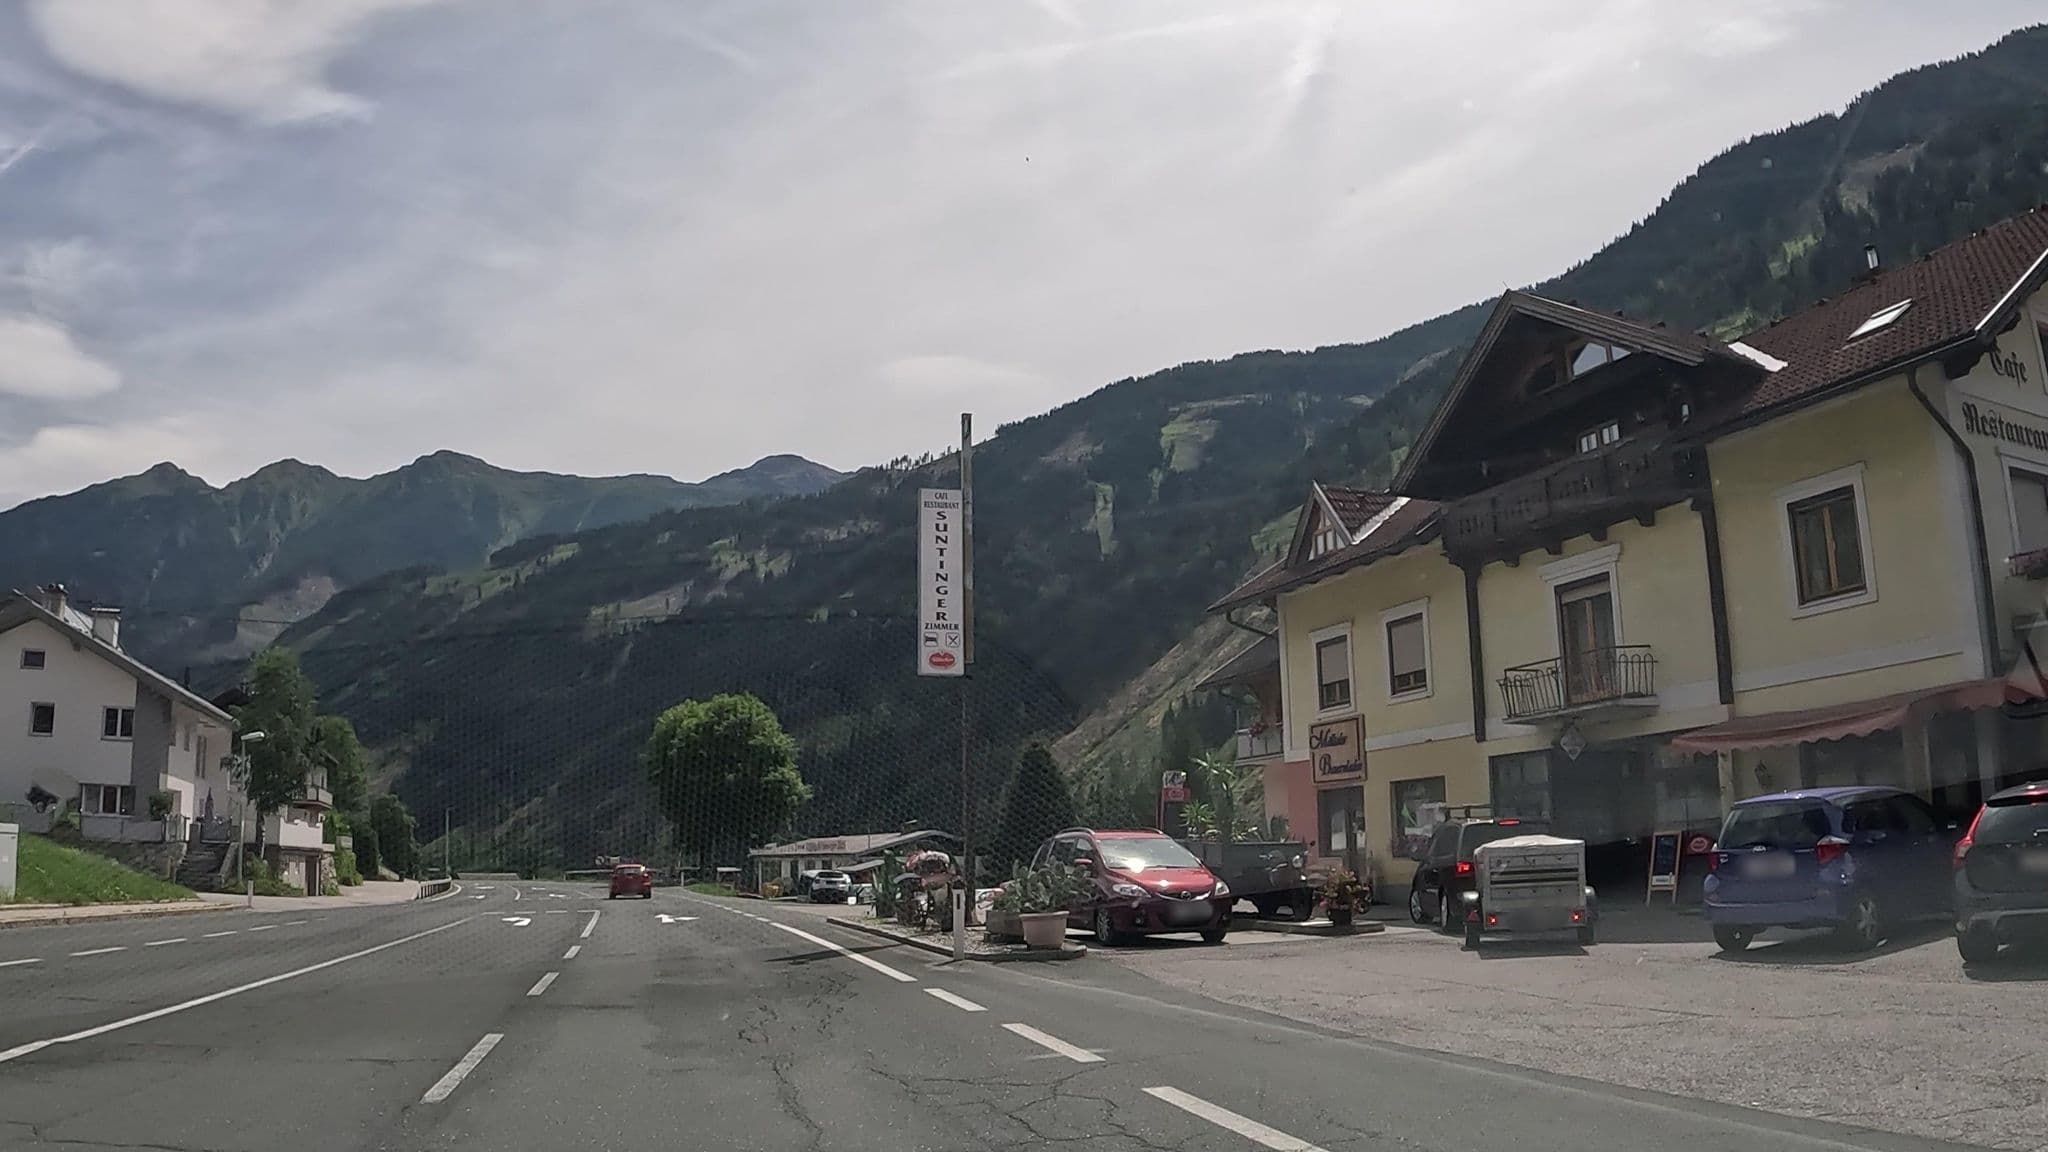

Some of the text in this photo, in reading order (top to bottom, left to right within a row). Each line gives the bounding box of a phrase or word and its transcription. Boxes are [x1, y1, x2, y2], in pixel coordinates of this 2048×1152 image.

[923, 500, 960, 509] RESTAURANT
[935, 510, 948, 622] SUNTINGER
[924, 622, 960, 631] ZIMMER
